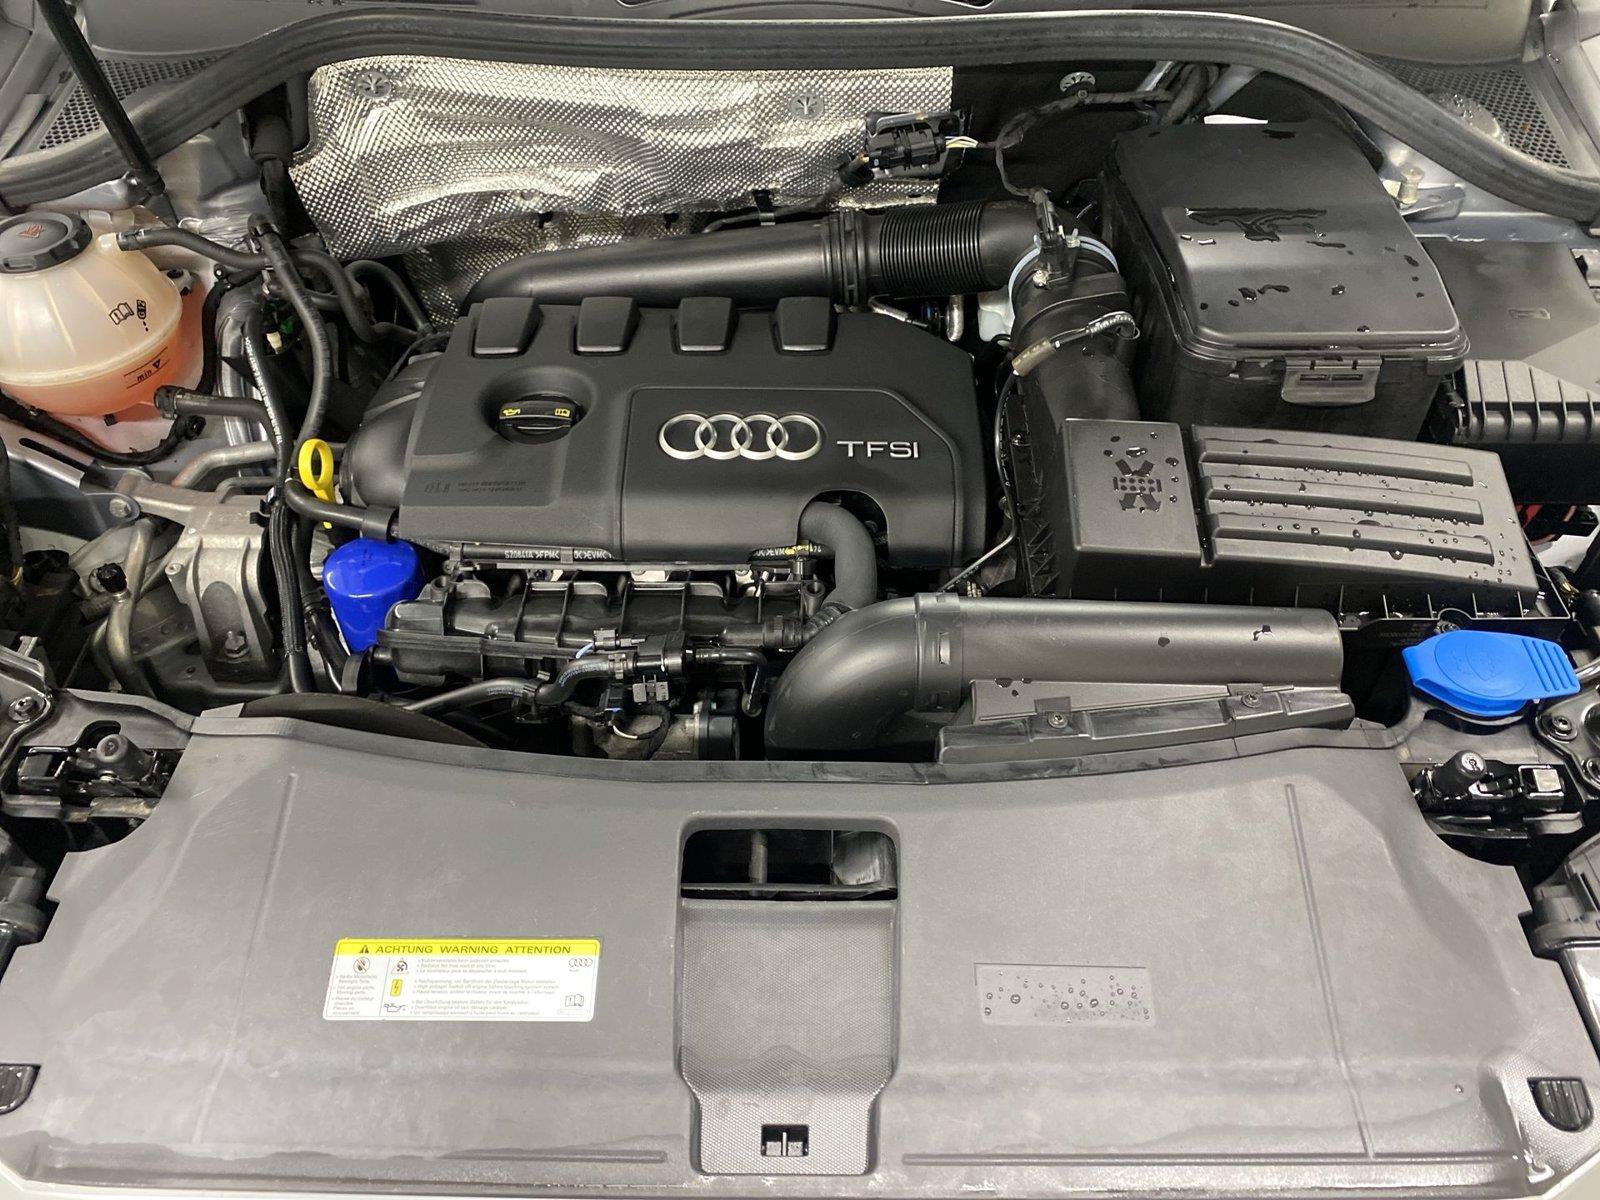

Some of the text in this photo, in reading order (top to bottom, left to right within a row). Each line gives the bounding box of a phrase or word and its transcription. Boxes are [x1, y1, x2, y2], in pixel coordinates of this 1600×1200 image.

[137, 369, 152, 382] min
[837, 440, 919, 458] TFSI
[376, 945, 571, 954] ACHTUNG WARNING ATTENTION
